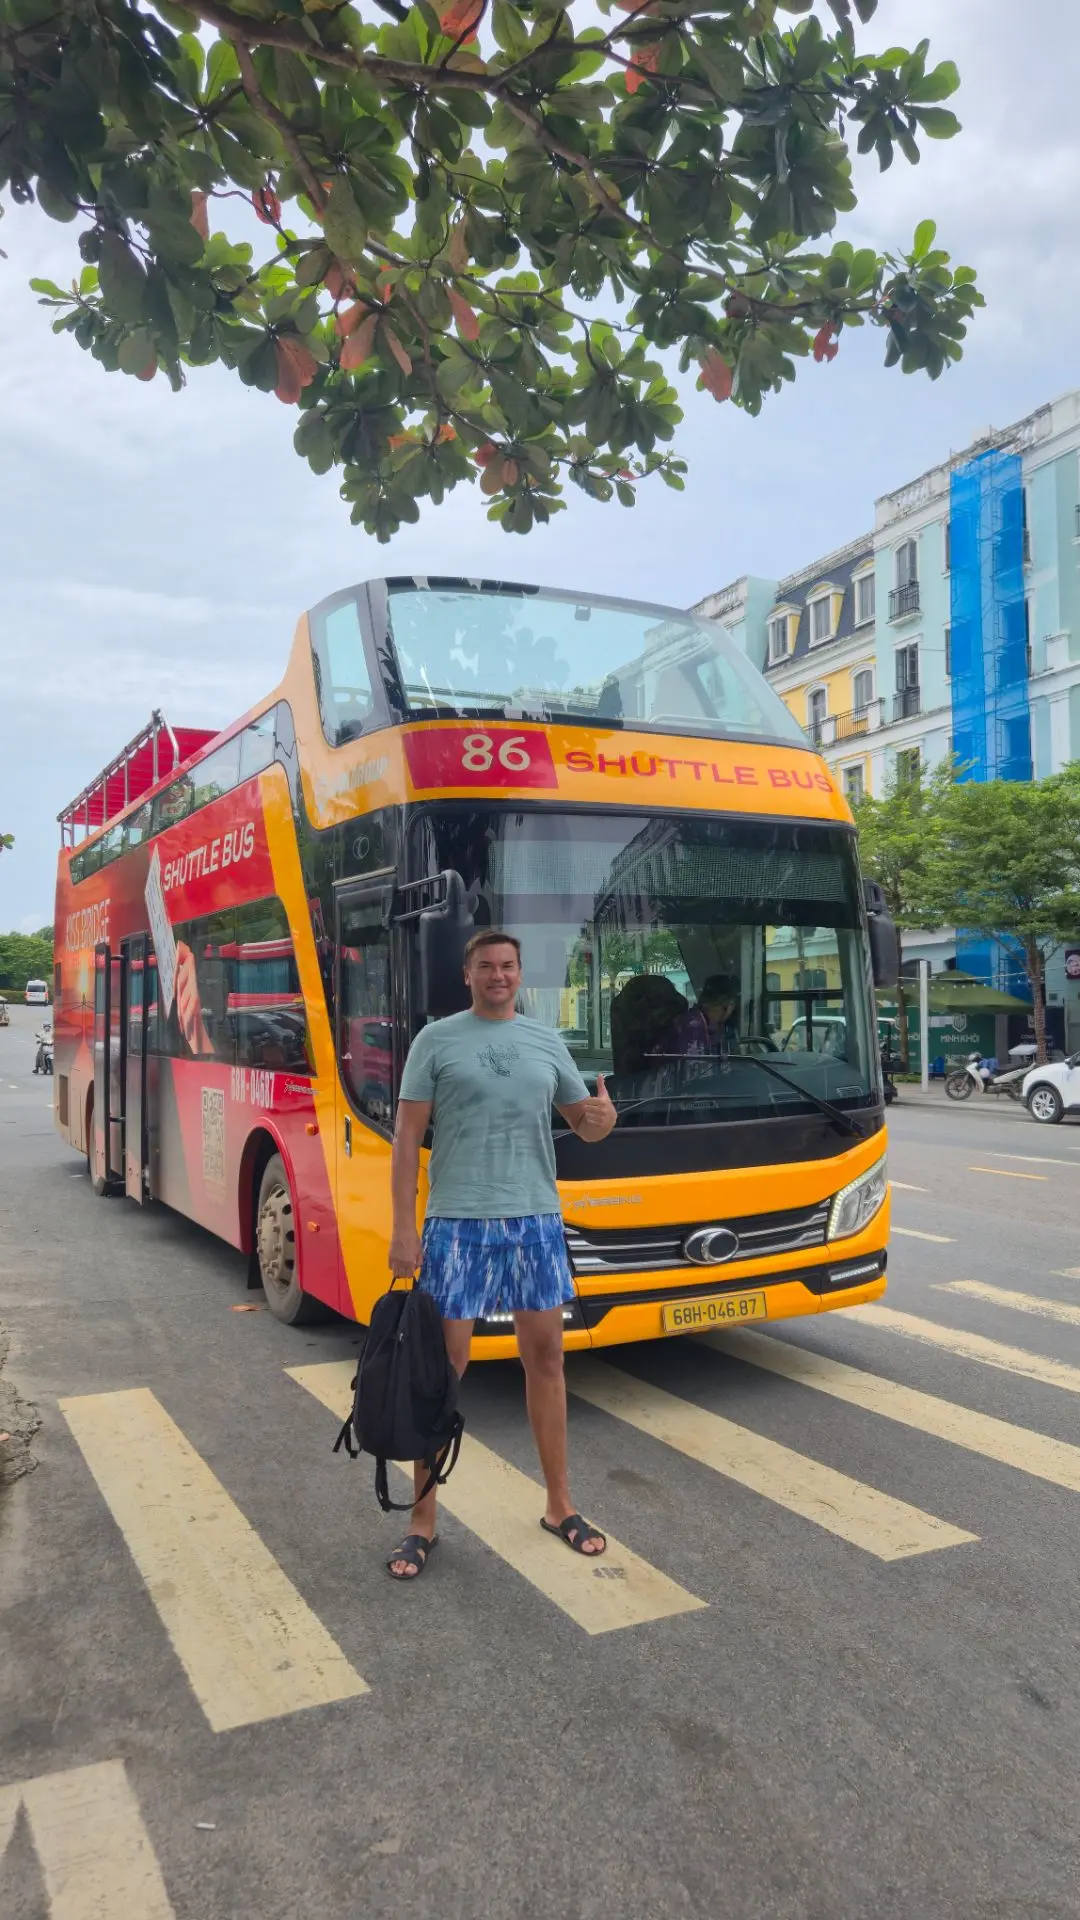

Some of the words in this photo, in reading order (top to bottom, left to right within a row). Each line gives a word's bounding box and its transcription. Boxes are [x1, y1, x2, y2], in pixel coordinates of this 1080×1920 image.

[461, 733, 531, 772] 86
[565, 751, 759, 786] SHUTTLE
[767, 768, 834, 793] BUS
[163, 838, 220, 892] SHUTTLE
[221, 822, 255, 868] BUS
[673, 1298, 756, 1326] 68H-046.87
